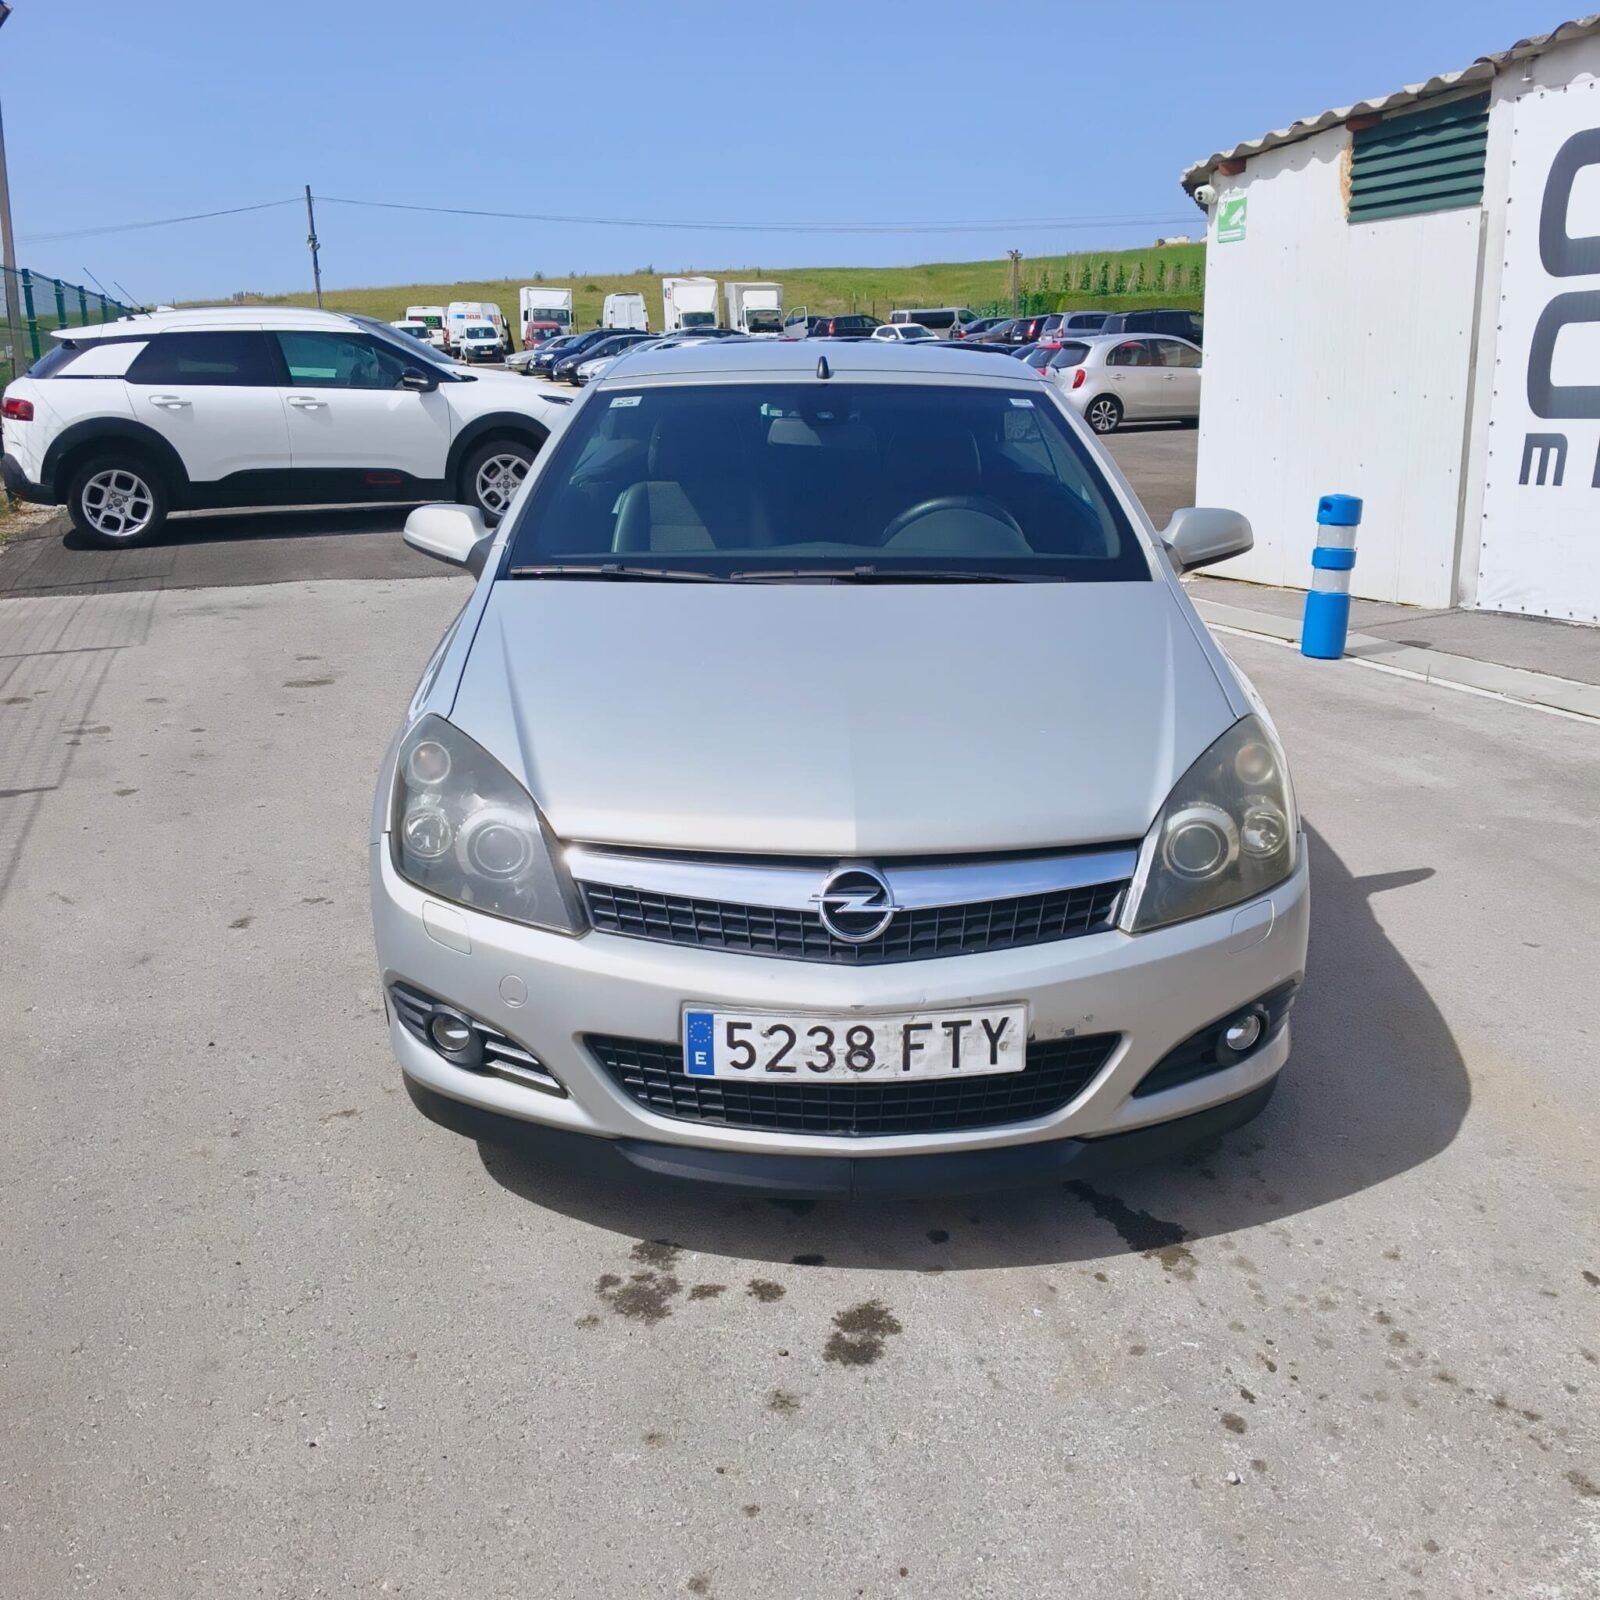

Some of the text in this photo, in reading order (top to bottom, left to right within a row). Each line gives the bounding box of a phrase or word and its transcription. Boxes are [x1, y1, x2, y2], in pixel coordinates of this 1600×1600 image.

[695, 1051, 707, 1065] E
[725, 1016, 1009, 1073] 5238 FTY
